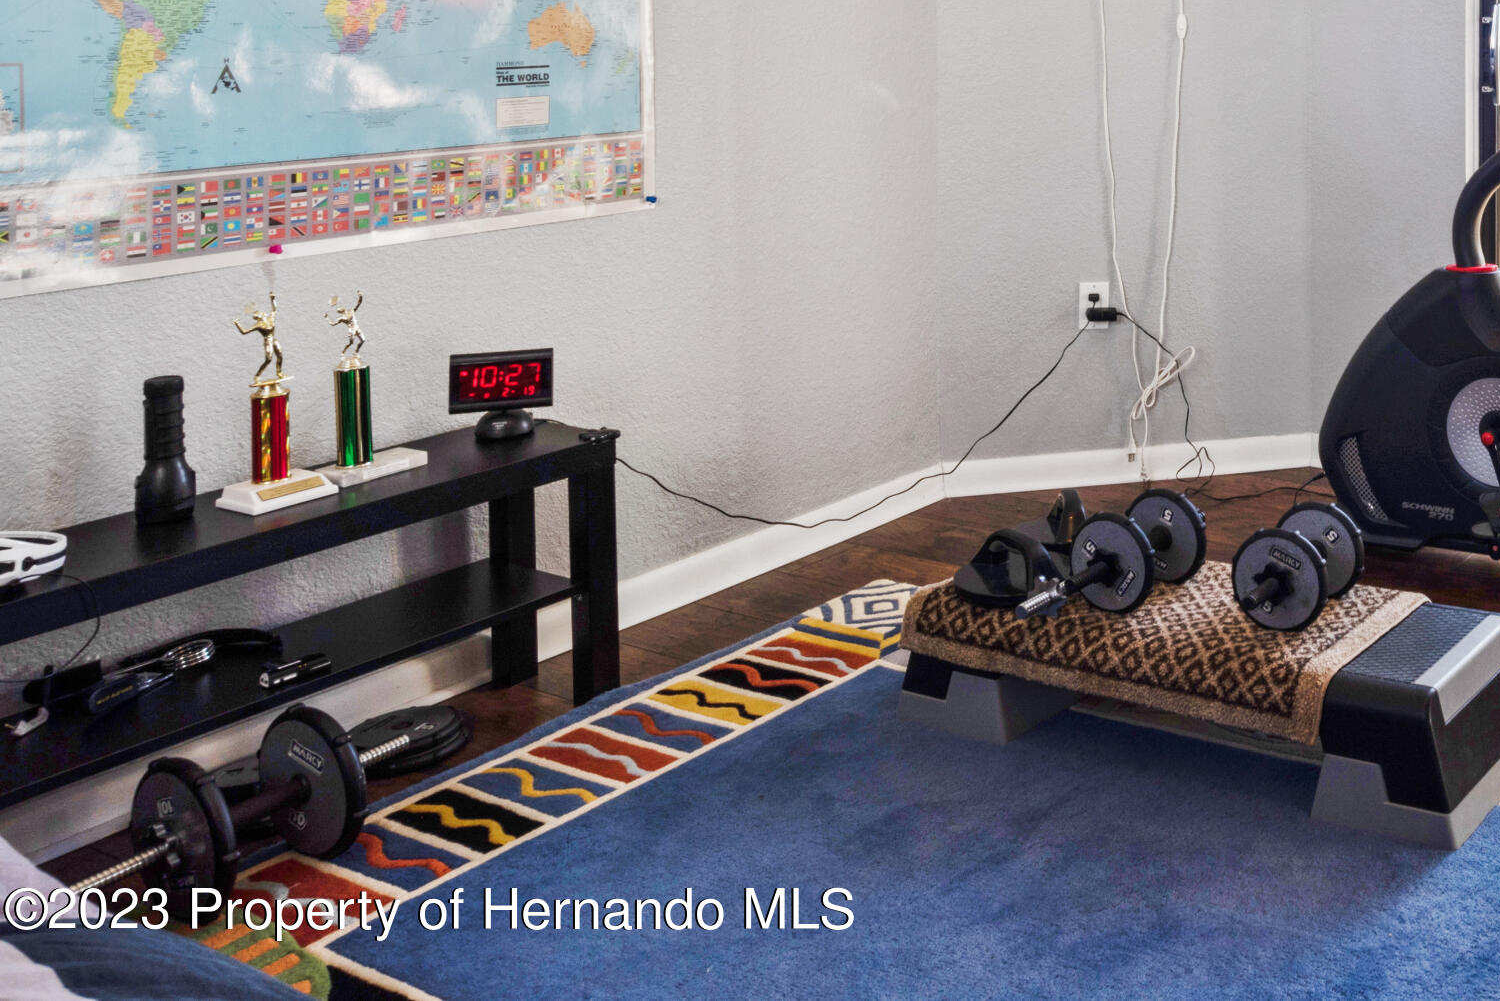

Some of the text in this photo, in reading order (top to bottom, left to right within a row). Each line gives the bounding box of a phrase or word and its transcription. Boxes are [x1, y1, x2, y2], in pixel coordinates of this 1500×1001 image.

[496, 73, 549, 83] THE WORLD
[472, 362, 541, 388] 10:27
[1401, 501, 1455, 514] SCHWINN
[1272, 549, 1301, 569] MARCY
[292, 743, 322, 769] MARCY
